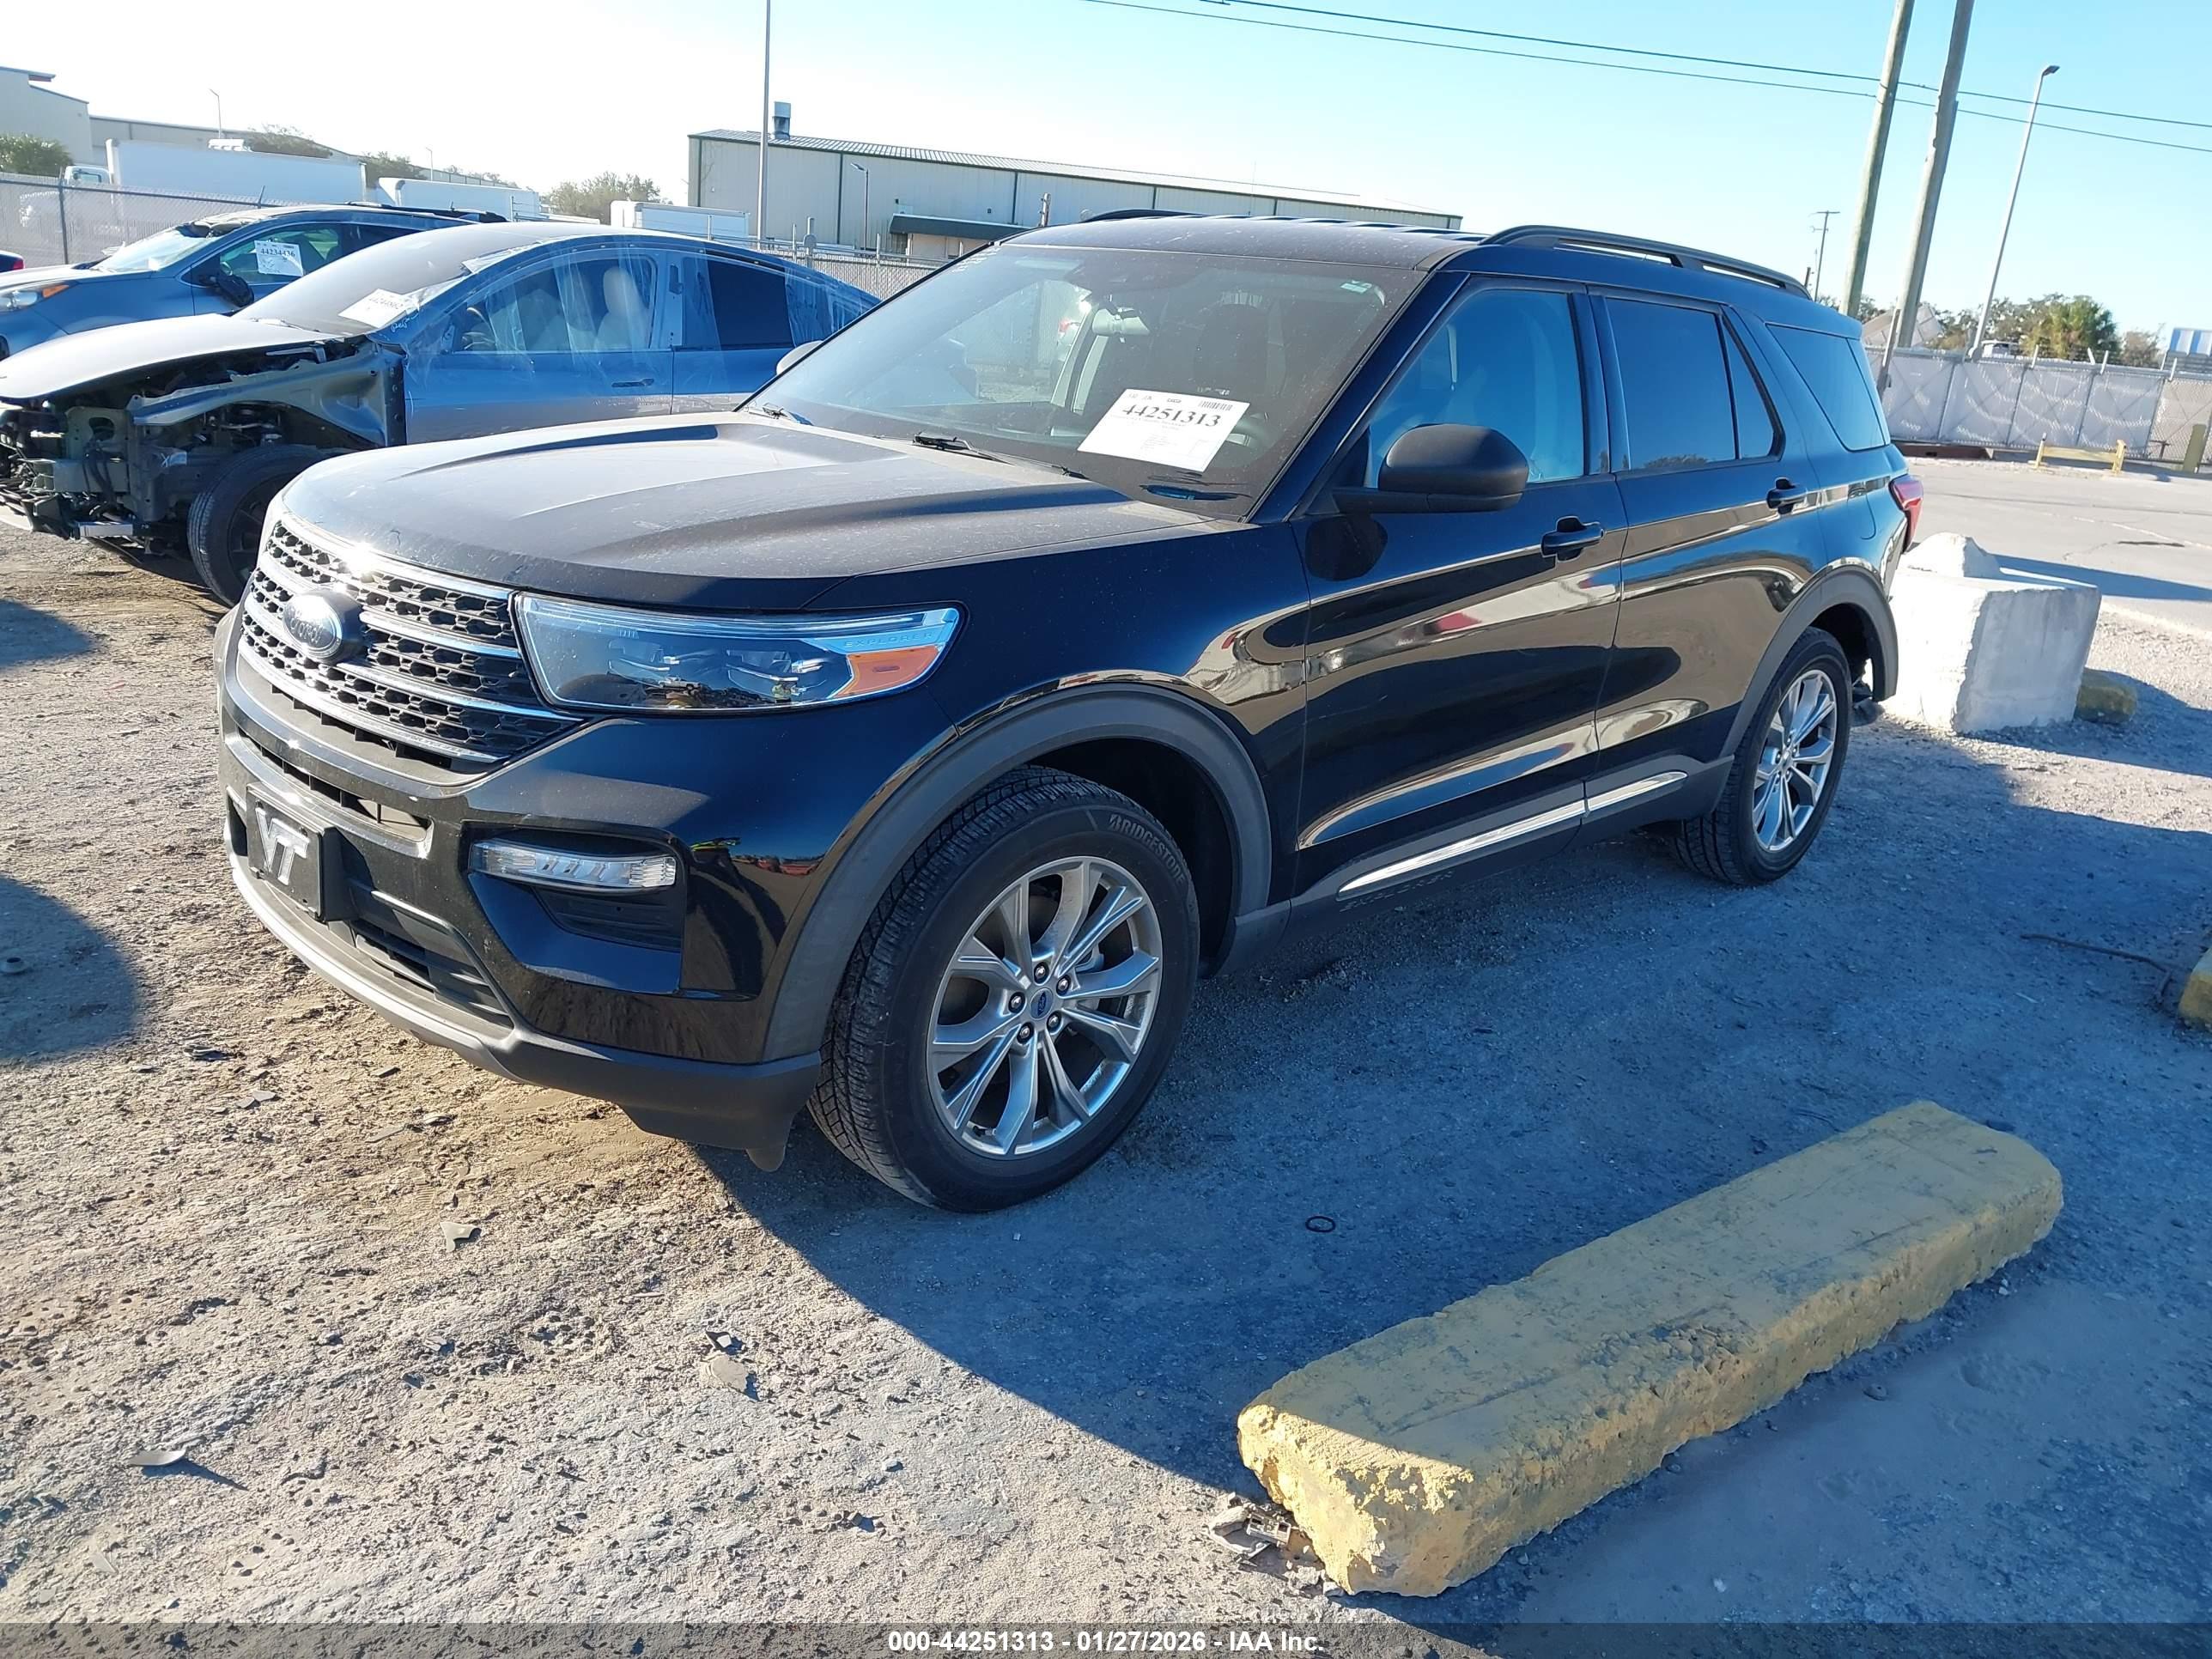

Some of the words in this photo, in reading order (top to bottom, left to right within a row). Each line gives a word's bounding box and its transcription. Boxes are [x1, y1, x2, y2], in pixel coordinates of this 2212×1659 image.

[1121, 404, 1222, 427] 44251313
[844, 633, 933, 647] EXPLORER
[254, 807, 310, 886] VT
[1107, 813, 1186, 884] BRIDGESTONE
